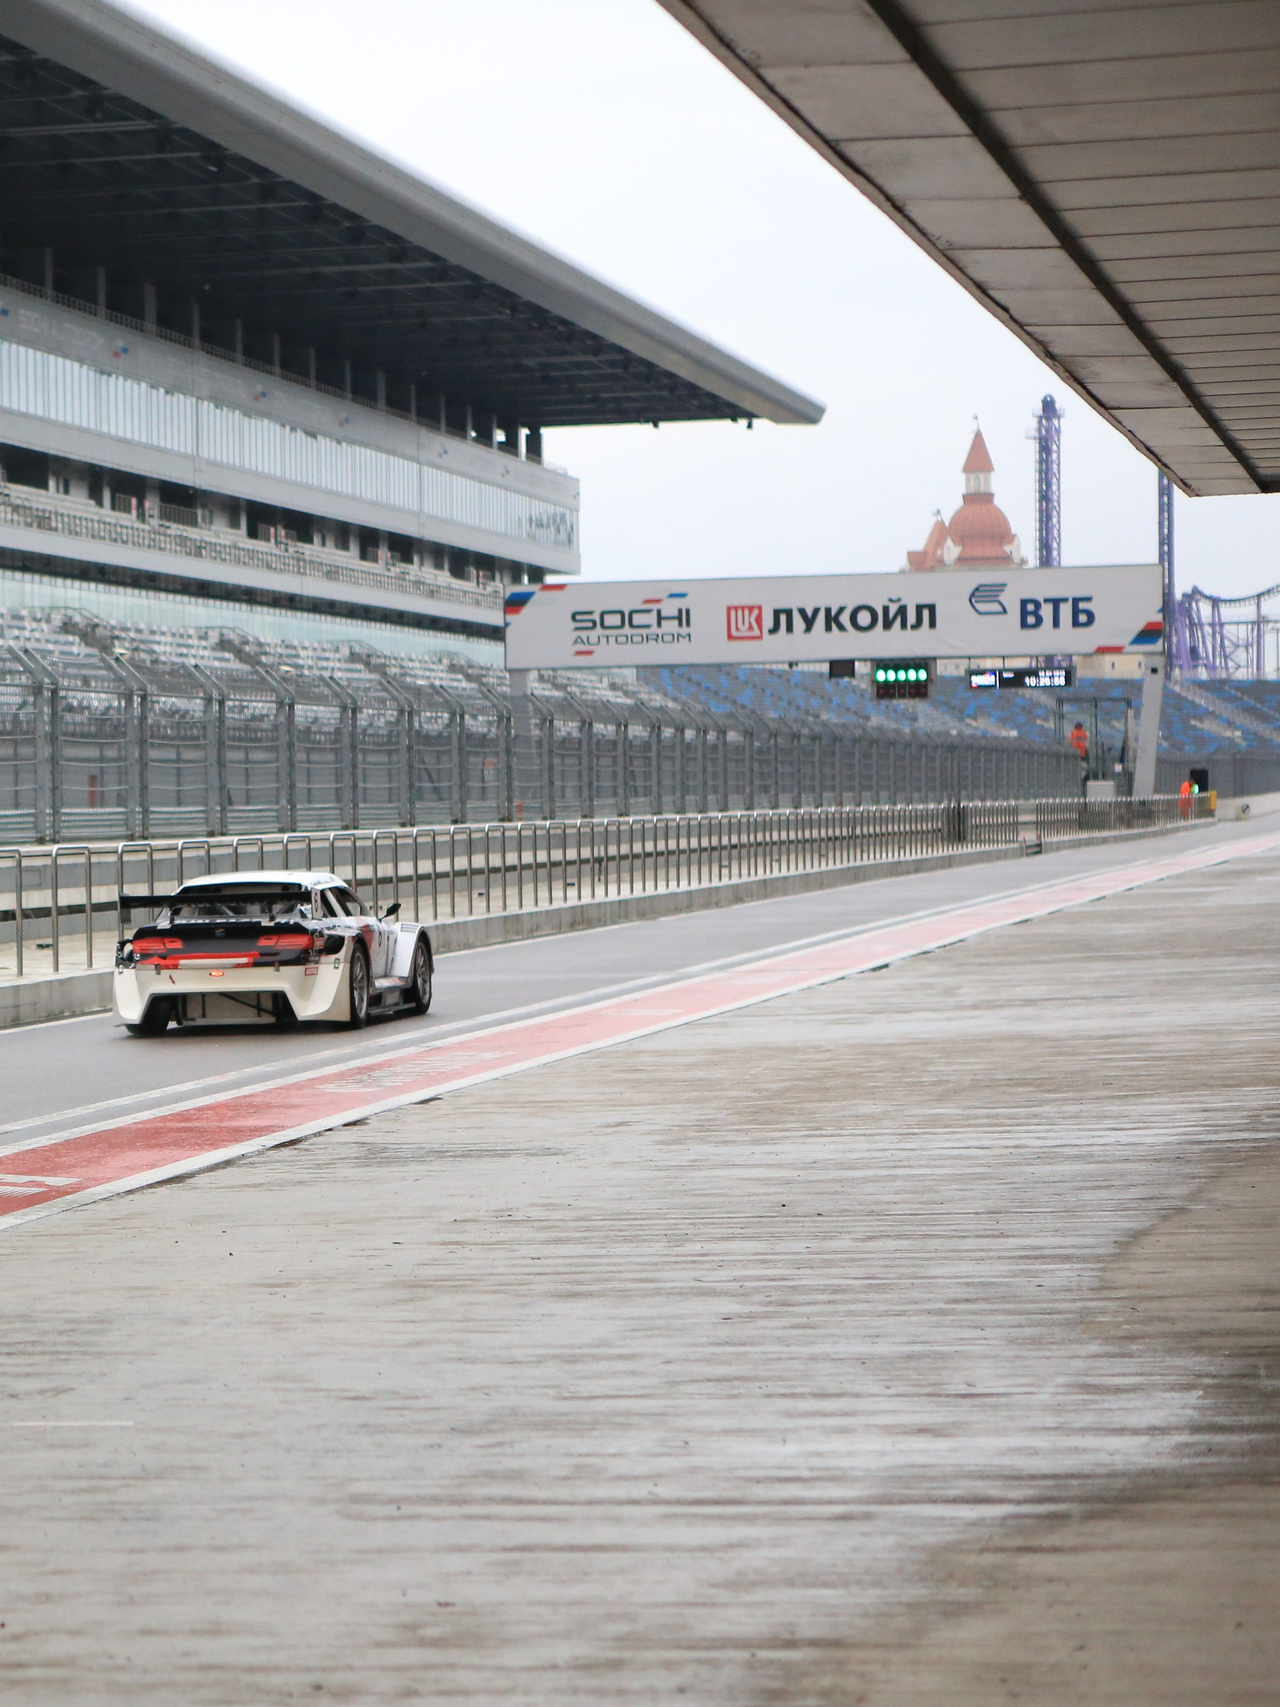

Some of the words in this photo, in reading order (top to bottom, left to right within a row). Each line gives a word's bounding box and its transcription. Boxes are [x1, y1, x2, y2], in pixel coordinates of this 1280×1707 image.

[571, 607, 692, 630] SOCHI
[768, 598, 937, 635] ЛУКОЙЛ
[1020, 597, 1096, 630] ВТБ
[572, 632, 692, 647] AUTODROM
